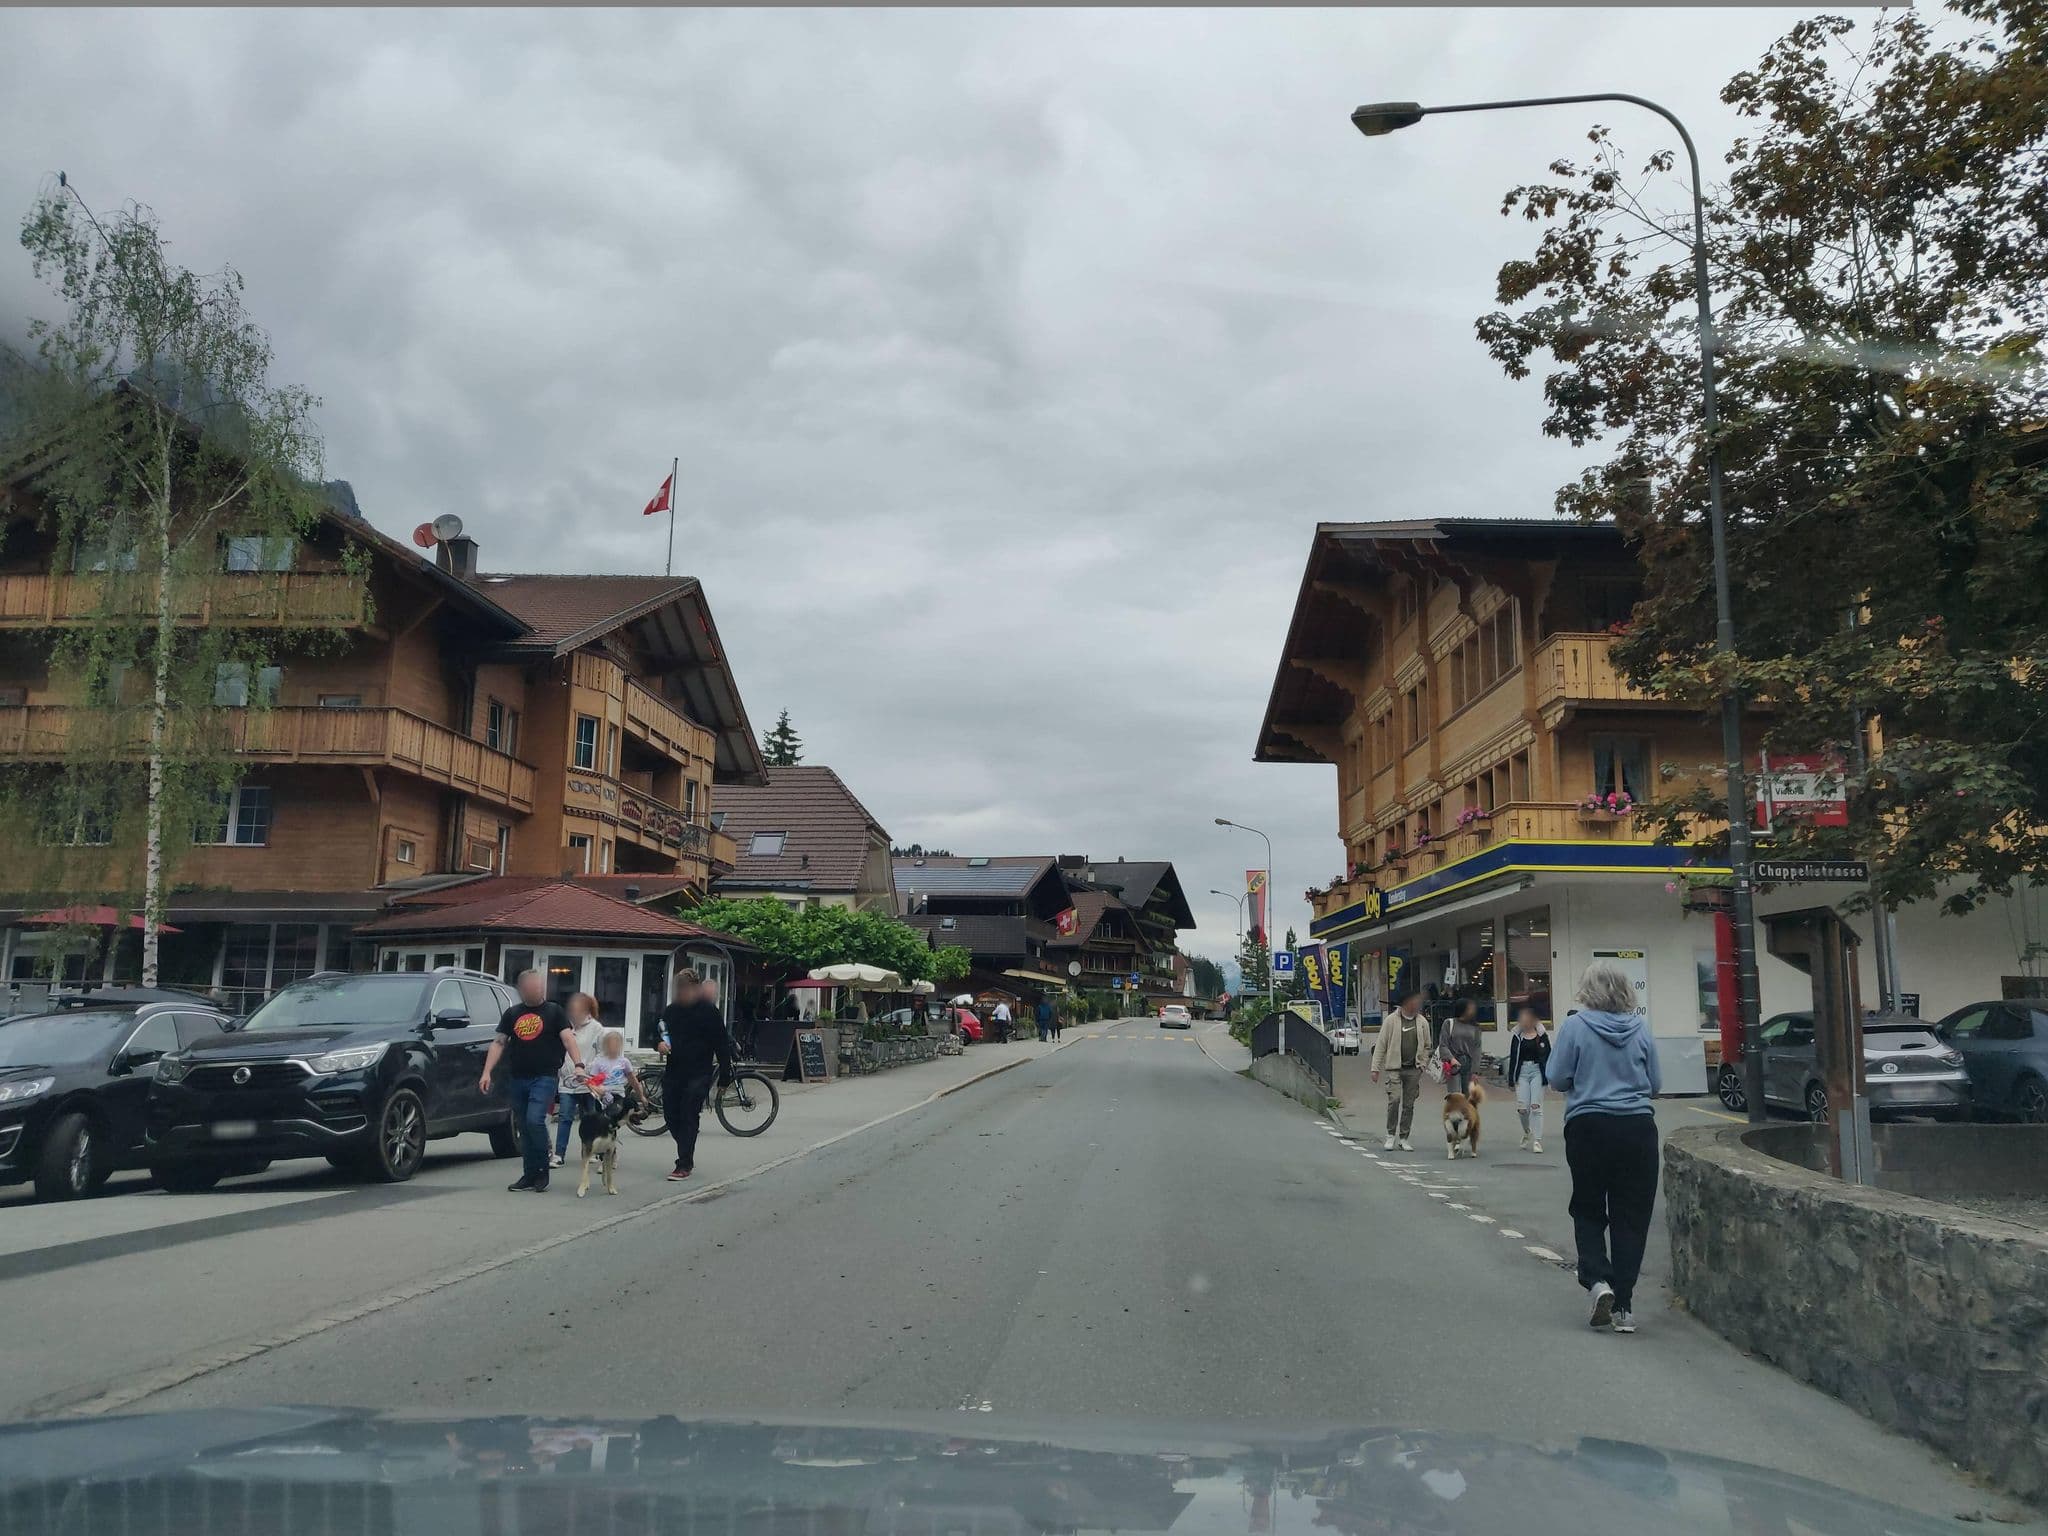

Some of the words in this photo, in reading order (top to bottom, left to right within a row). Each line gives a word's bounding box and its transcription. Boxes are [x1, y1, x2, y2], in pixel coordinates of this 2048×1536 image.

[1758, 863, 1864, 880] Chappelistrasse
[1365, 890, 1380, 918] Volg
[1280, 955, 1289, 969] P
